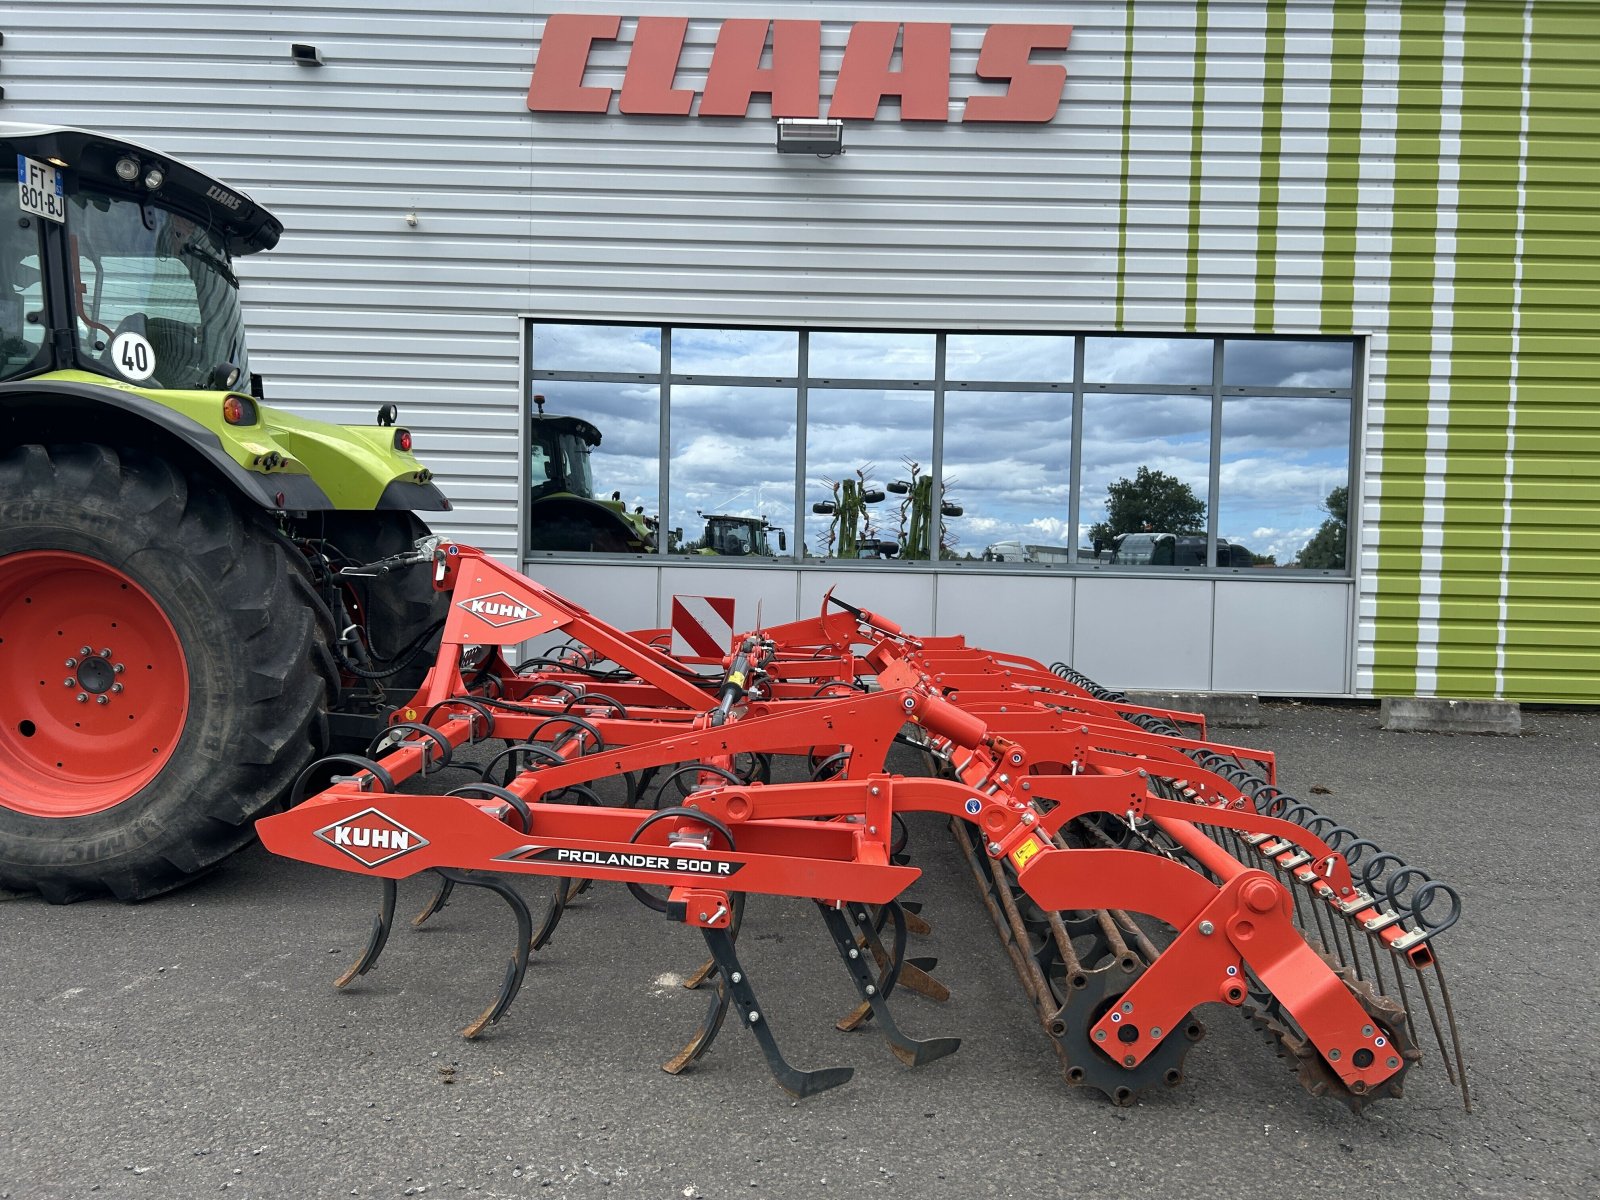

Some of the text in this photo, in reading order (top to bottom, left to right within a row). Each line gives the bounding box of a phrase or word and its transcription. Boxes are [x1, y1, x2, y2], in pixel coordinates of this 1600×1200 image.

[527, 14, 1073, 123] CLAAS
[206, 185, 242, 210] CLAAS
[122, 341, 147, 372] 40
[471, 600, 527, 619] KUHN
[334, 826, 409, 850] KUHN
[558, 849, 731, 874] PROLANDER 500 R
